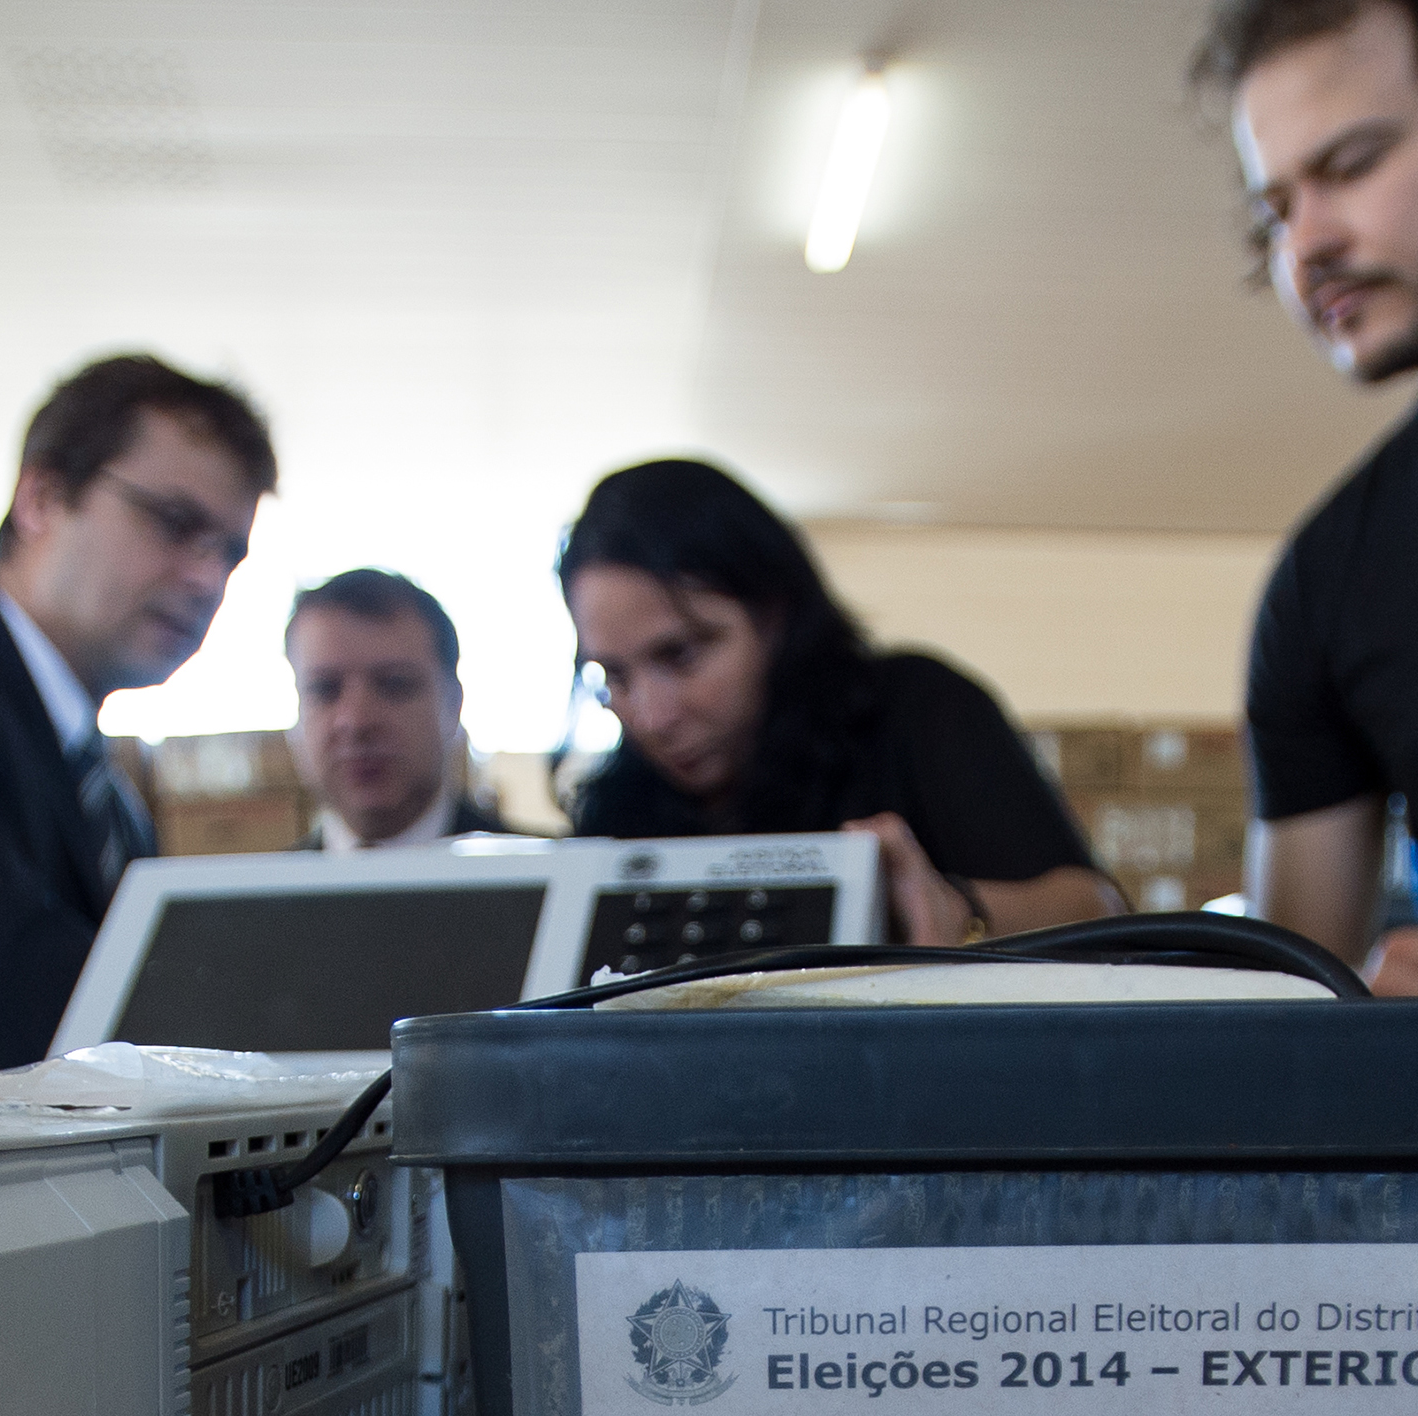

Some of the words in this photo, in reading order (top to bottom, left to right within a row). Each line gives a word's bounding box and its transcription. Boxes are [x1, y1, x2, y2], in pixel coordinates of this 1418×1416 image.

[762, 1305, 907, 1337] Tribunal
[923, 1303, 1078, 1342] Regional
[1093, 1301, 1240, 1333] Eleitoral
[1255, 1301, 1301, 1333] do
[767, 1350, 979, 1399] Eleições
[1000, 1351, 1131, 1389] 2014
